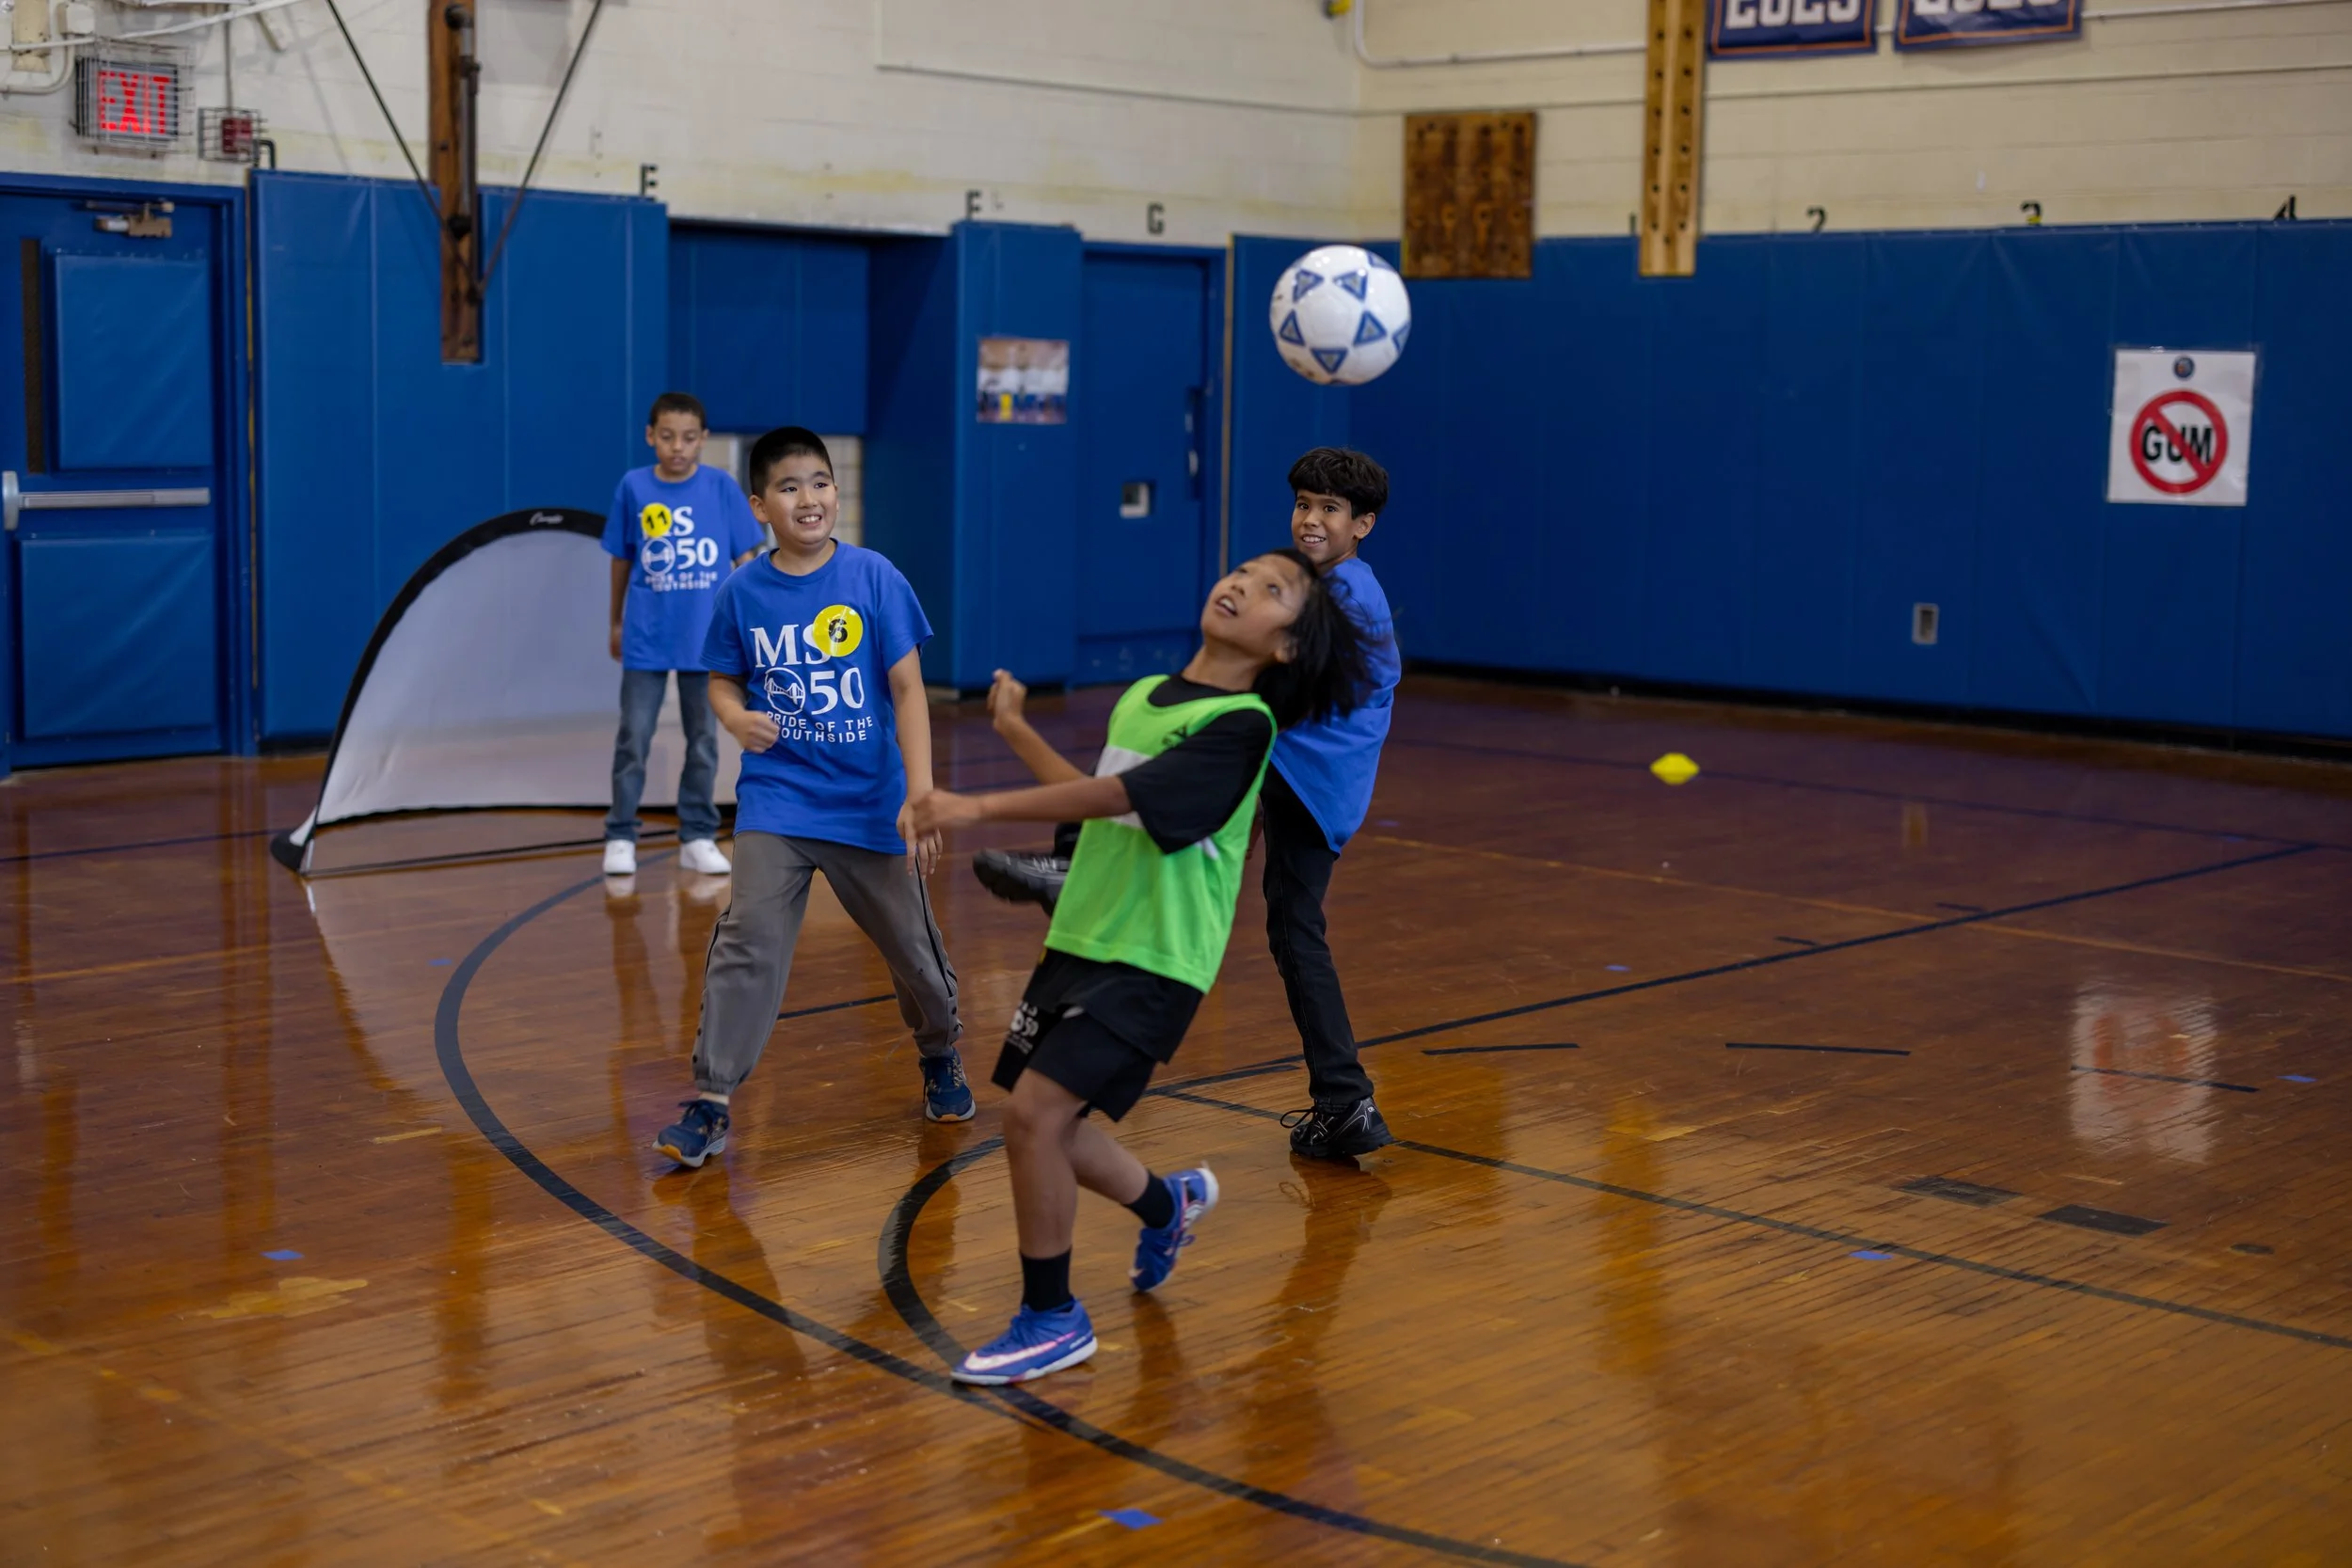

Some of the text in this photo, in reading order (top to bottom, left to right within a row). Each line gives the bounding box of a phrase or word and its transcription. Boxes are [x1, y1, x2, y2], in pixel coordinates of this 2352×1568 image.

[99, 71, 169, 135] EXIT
[1147, 201, 1165, 235] G
[2142, 425, 2212, 467] GUM
[645, 511, 668, 530] 11
[675, 537, 719, 570] 50
[828, 618, 849, 643] 6
[809, 667, 866, 716] 50
[766, 711, 873, 733] PRIDE OF THE
[780, 727, 867, 743] OUTHSIDE
